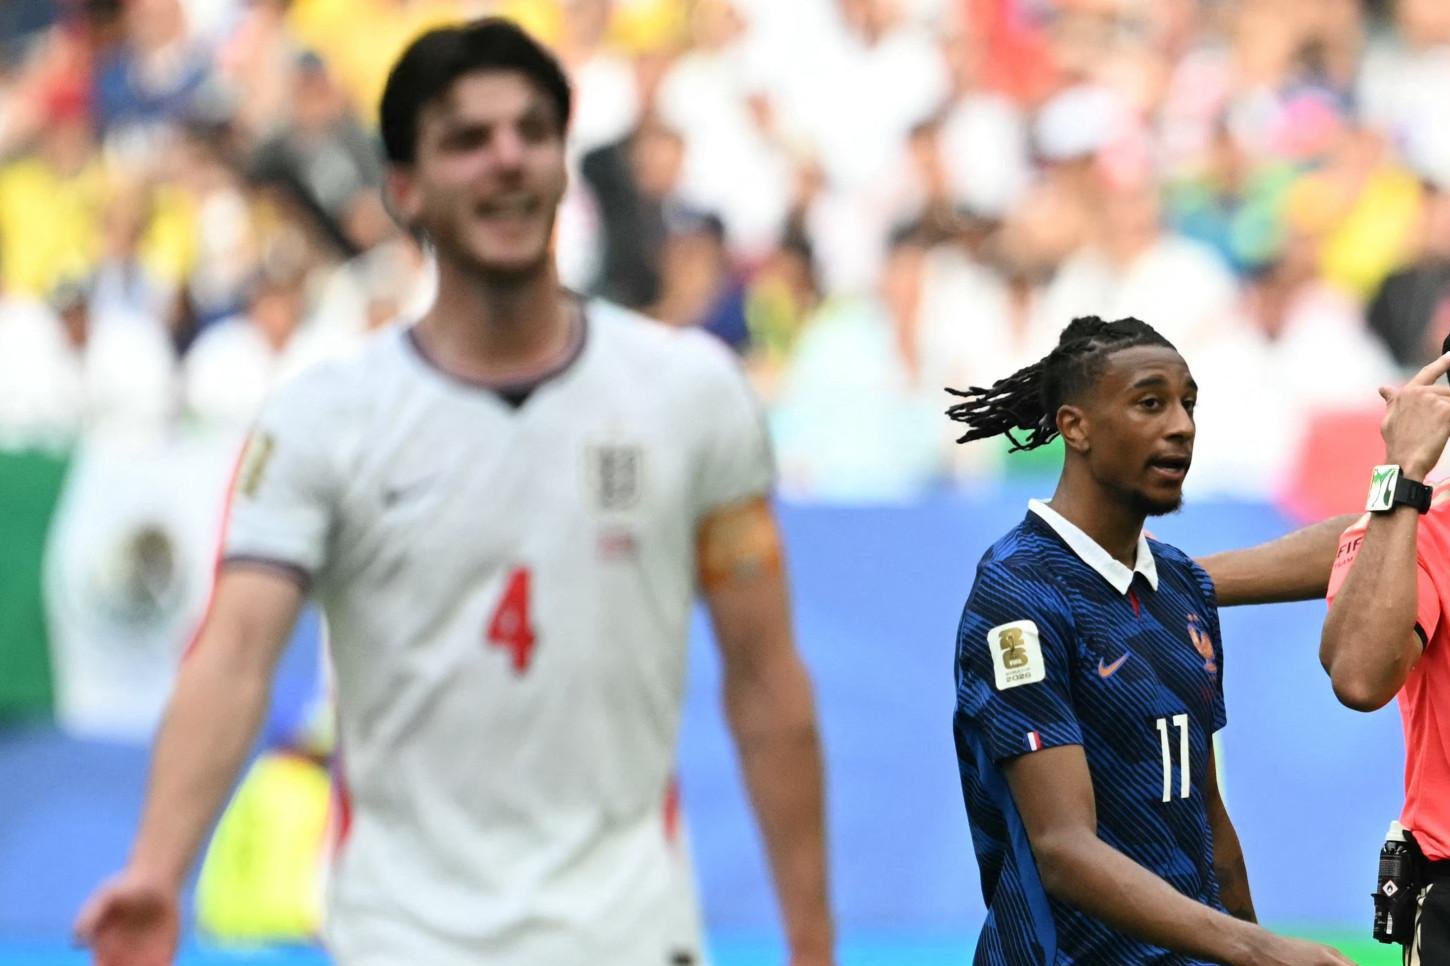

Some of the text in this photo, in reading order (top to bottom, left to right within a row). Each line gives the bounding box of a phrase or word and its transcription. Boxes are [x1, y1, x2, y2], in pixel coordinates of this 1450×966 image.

[1337, 536, 1364, 558] FIF
[486, 565, 538, 676] 4
[1156, 713, 1190, 803] 11
